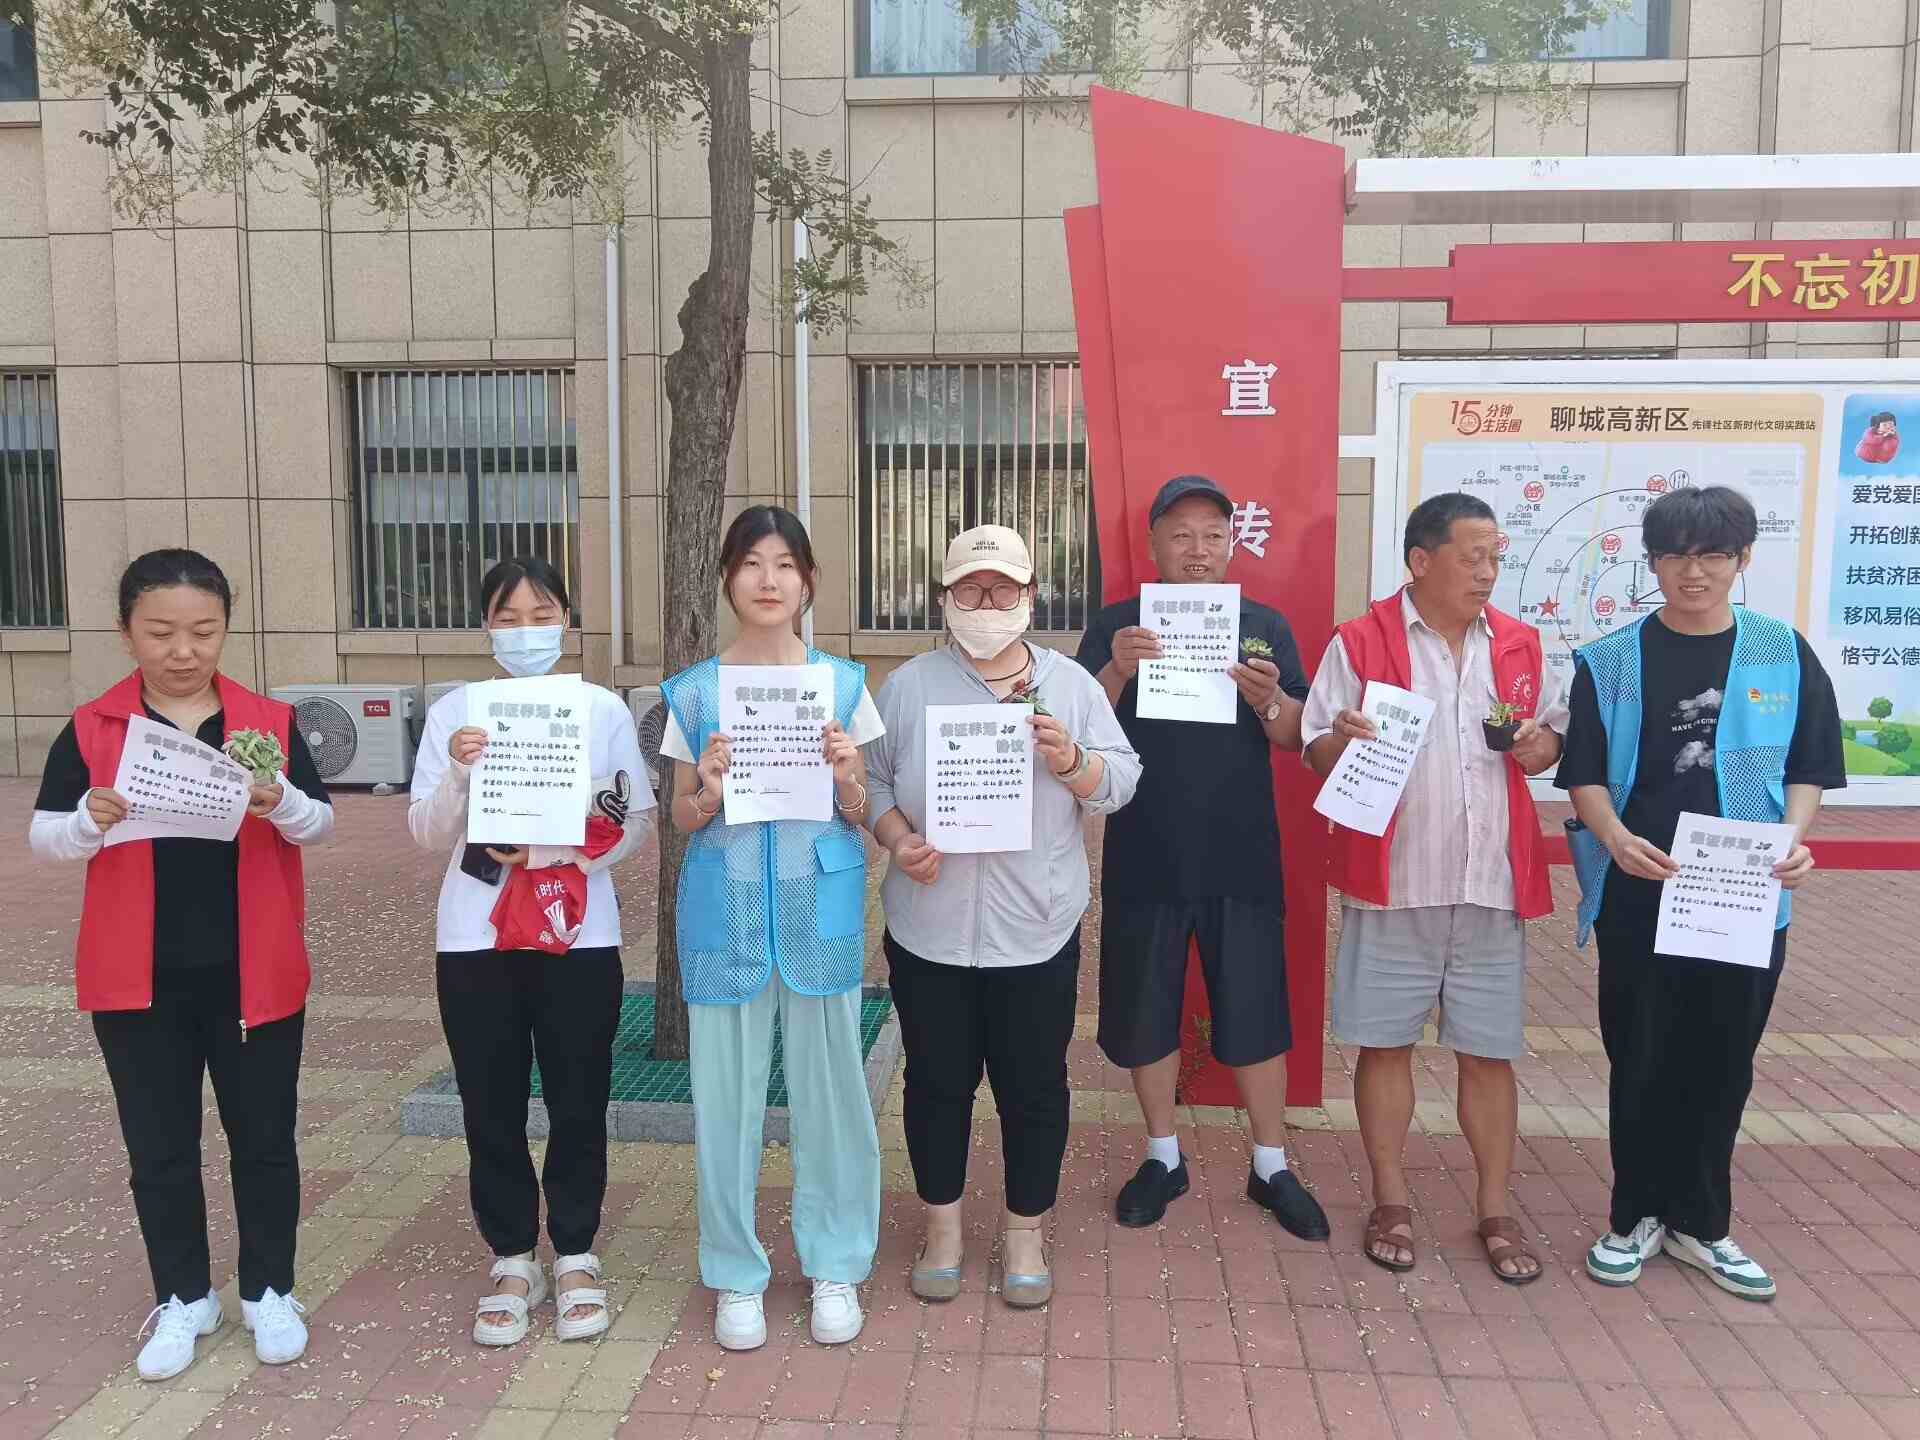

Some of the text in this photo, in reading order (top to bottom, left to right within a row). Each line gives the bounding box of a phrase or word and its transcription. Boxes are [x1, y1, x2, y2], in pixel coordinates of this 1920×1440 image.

[1727, 248, 1920, 310] 不忘初
[1451, 400, 1482, 435] 15
[1486, 403, 1513, 418] 分钟
[1550, 406, 1690, 433] 聊城高新区
[1843, 606, 1920, 625] 移风易俗
[1841, 645, 1920, 665] 恪守公德
[367, 705, 388, 713] TCL
